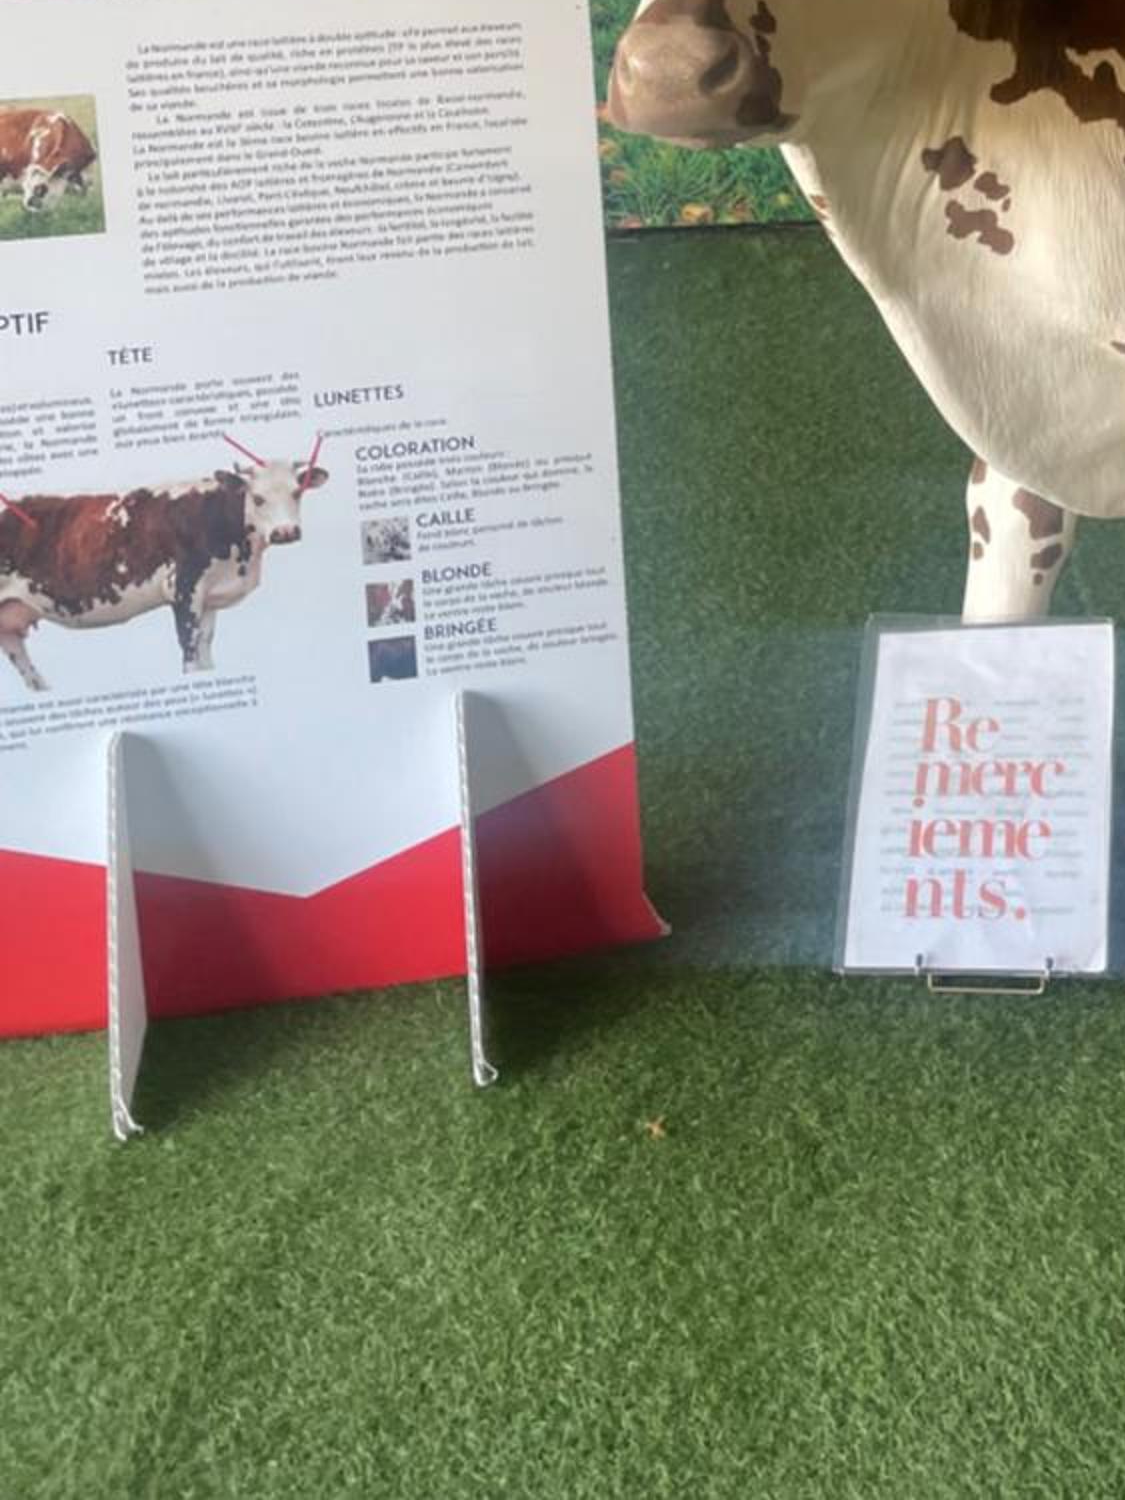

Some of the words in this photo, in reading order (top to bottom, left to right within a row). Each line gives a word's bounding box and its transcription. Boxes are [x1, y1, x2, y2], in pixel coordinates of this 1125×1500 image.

[314, 384, 404, 407] LUNETTES
[355, 436, 475, 460] COLORATION
[416, 508, 475, 527] CAILLE
[422, 562, 491, 583] BLONDE
